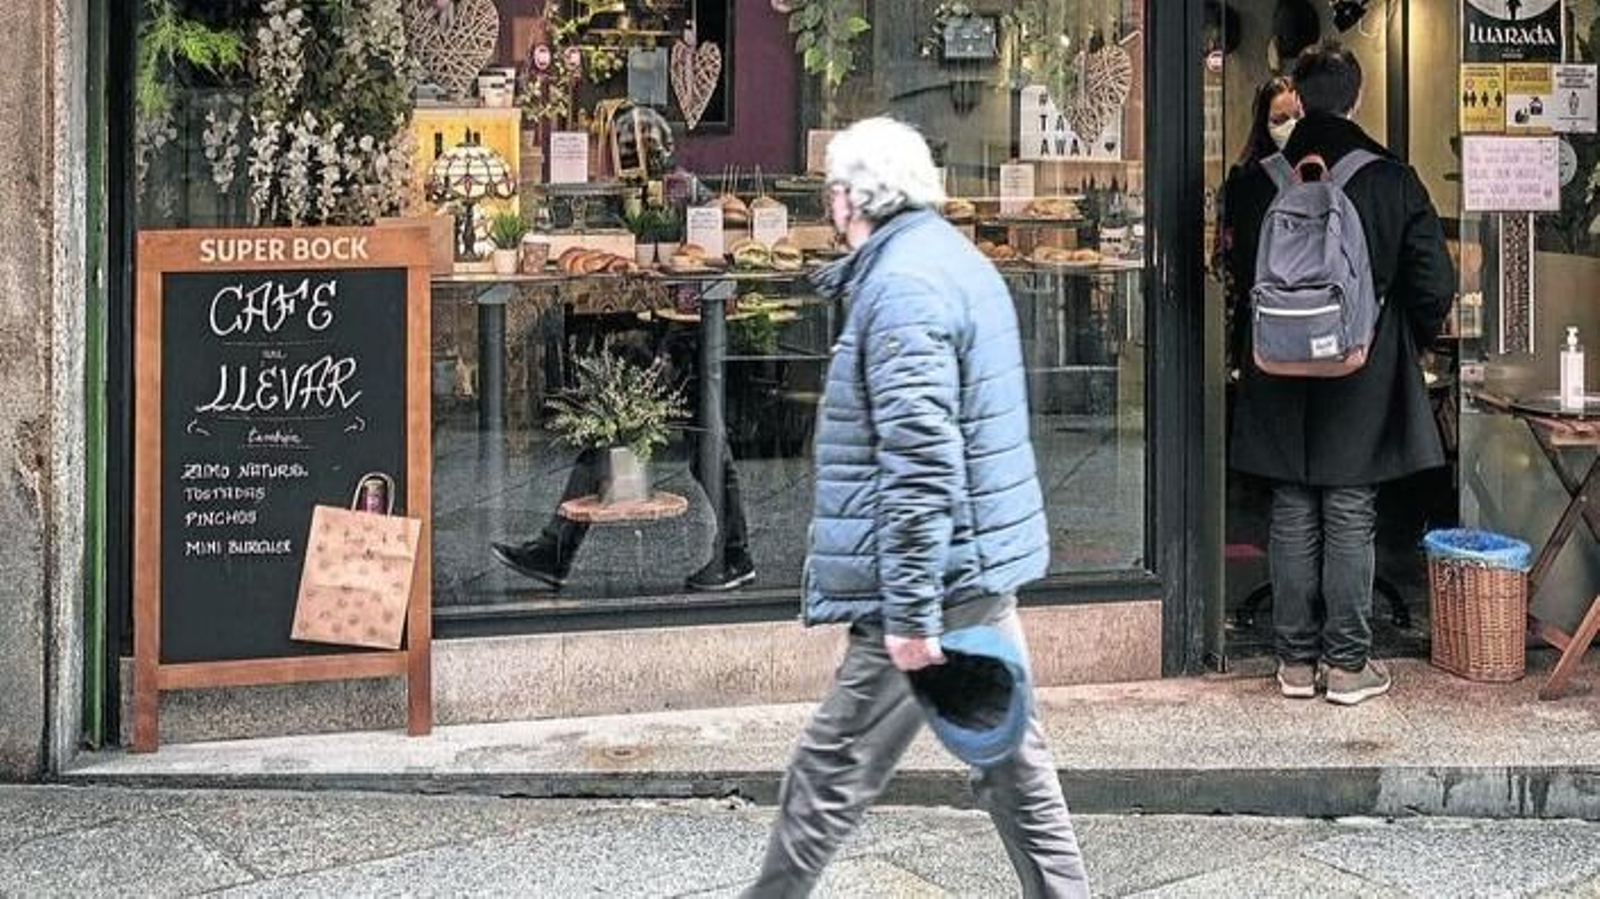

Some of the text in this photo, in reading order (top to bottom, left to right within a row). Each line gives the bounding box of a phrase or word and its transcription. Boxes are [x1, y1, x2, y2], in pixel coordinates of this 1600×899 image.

[200, 237, 368, 262] SUPER BOCK
[196, 355, 362, 412] LLEVAR
[184, 486, 266, 501] TOSTADAS
[185, 510, 257, 526] PINCHOS
[185, 541, 221, 556] MINI
